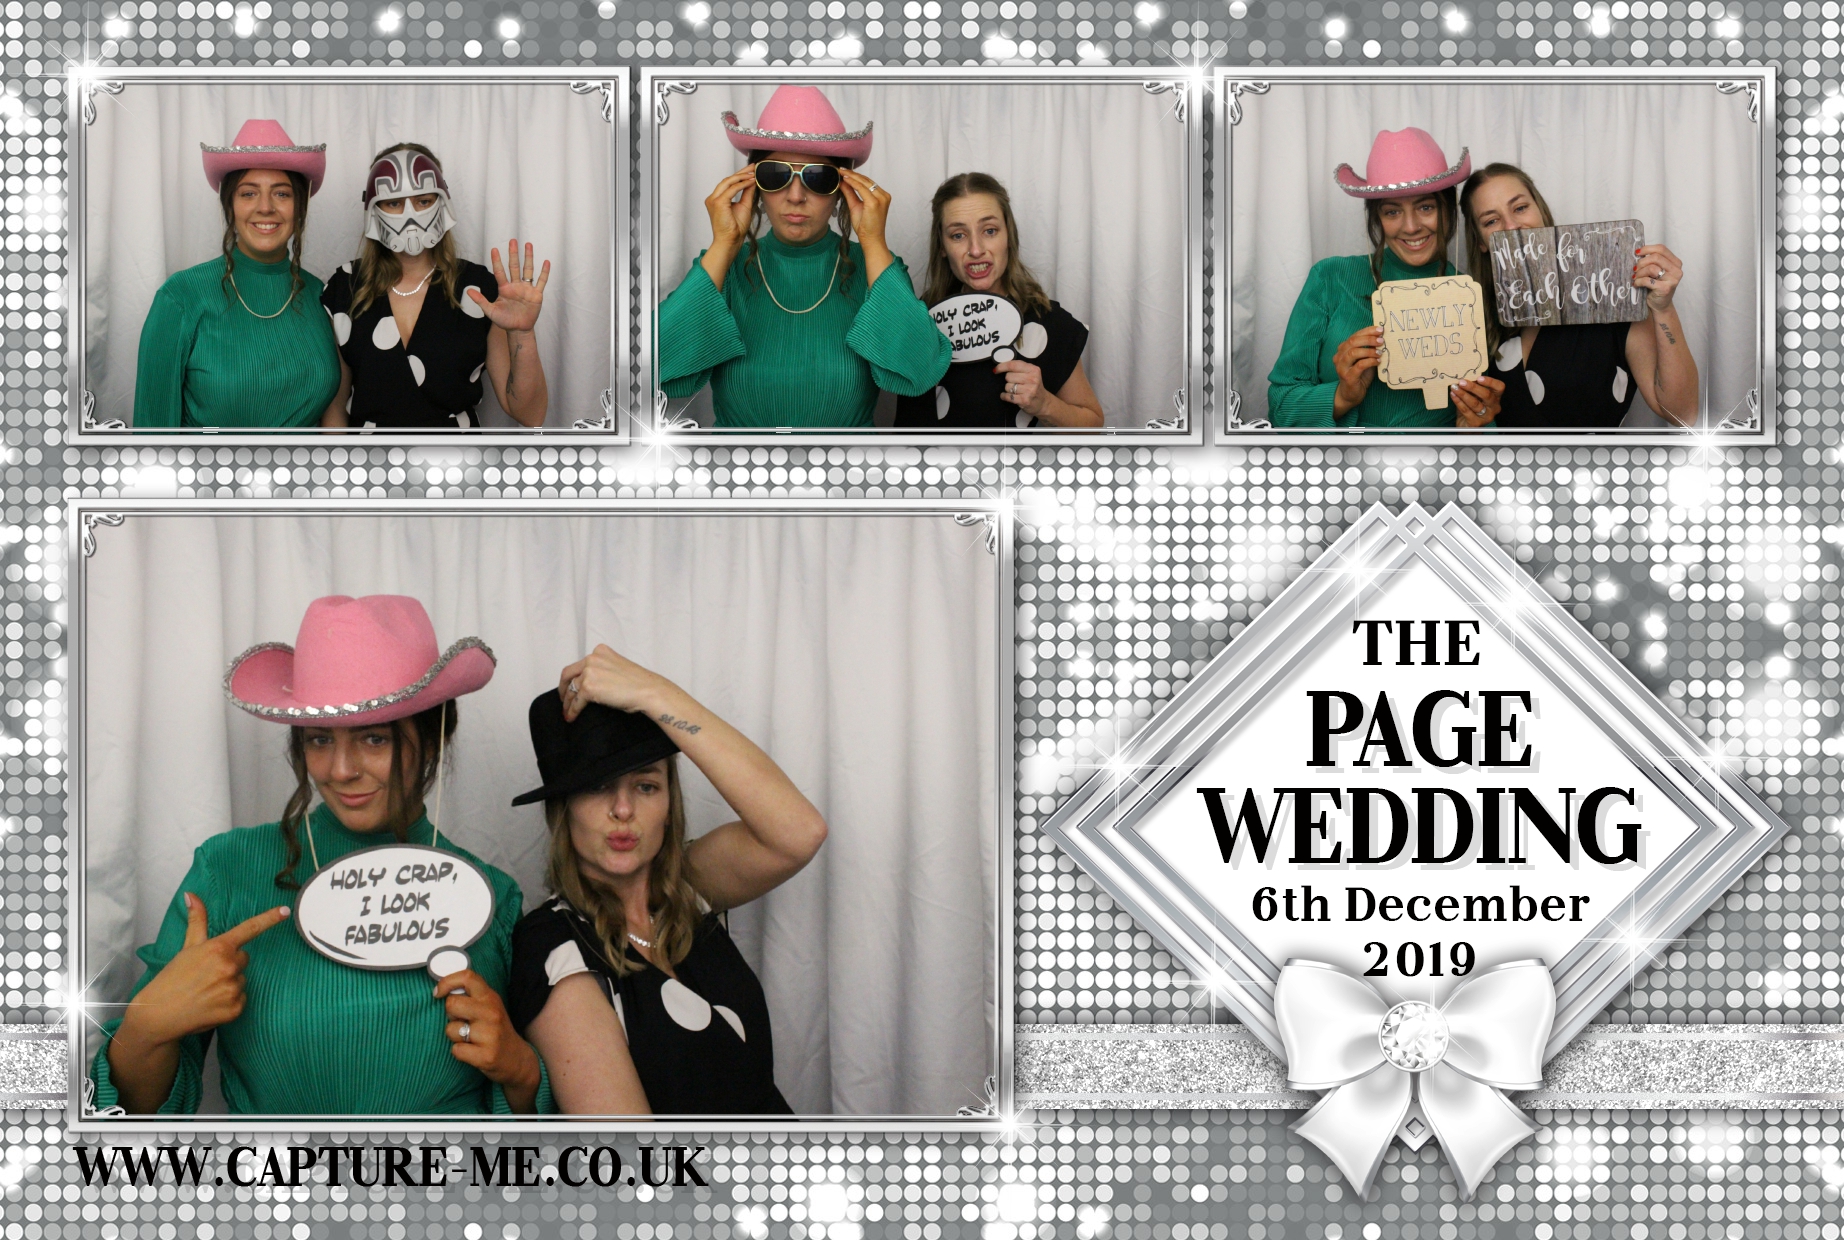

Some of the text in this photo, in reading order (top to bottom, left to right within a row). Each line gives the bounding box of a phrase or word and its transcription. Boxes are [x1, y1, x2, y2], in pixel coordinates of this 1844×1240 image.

[1494, 231, 1587, 272] Made for
[1508, 267, 1640, 310] Each Other
[963, 299, 998, 317] CRAP,
[1389, 303, 1467, 332] NEWLY
[948, 318, 986, 337] I LOOK
[951, 330, 1000, 351] ABULOUS
[1398, 332, 1464, 360] WEDS
[330, 862, 457, 890] HOLY CRAP,
[360, 892, 430, 917] I LOOK
[345, 917, 450, 946] FABULOUS
